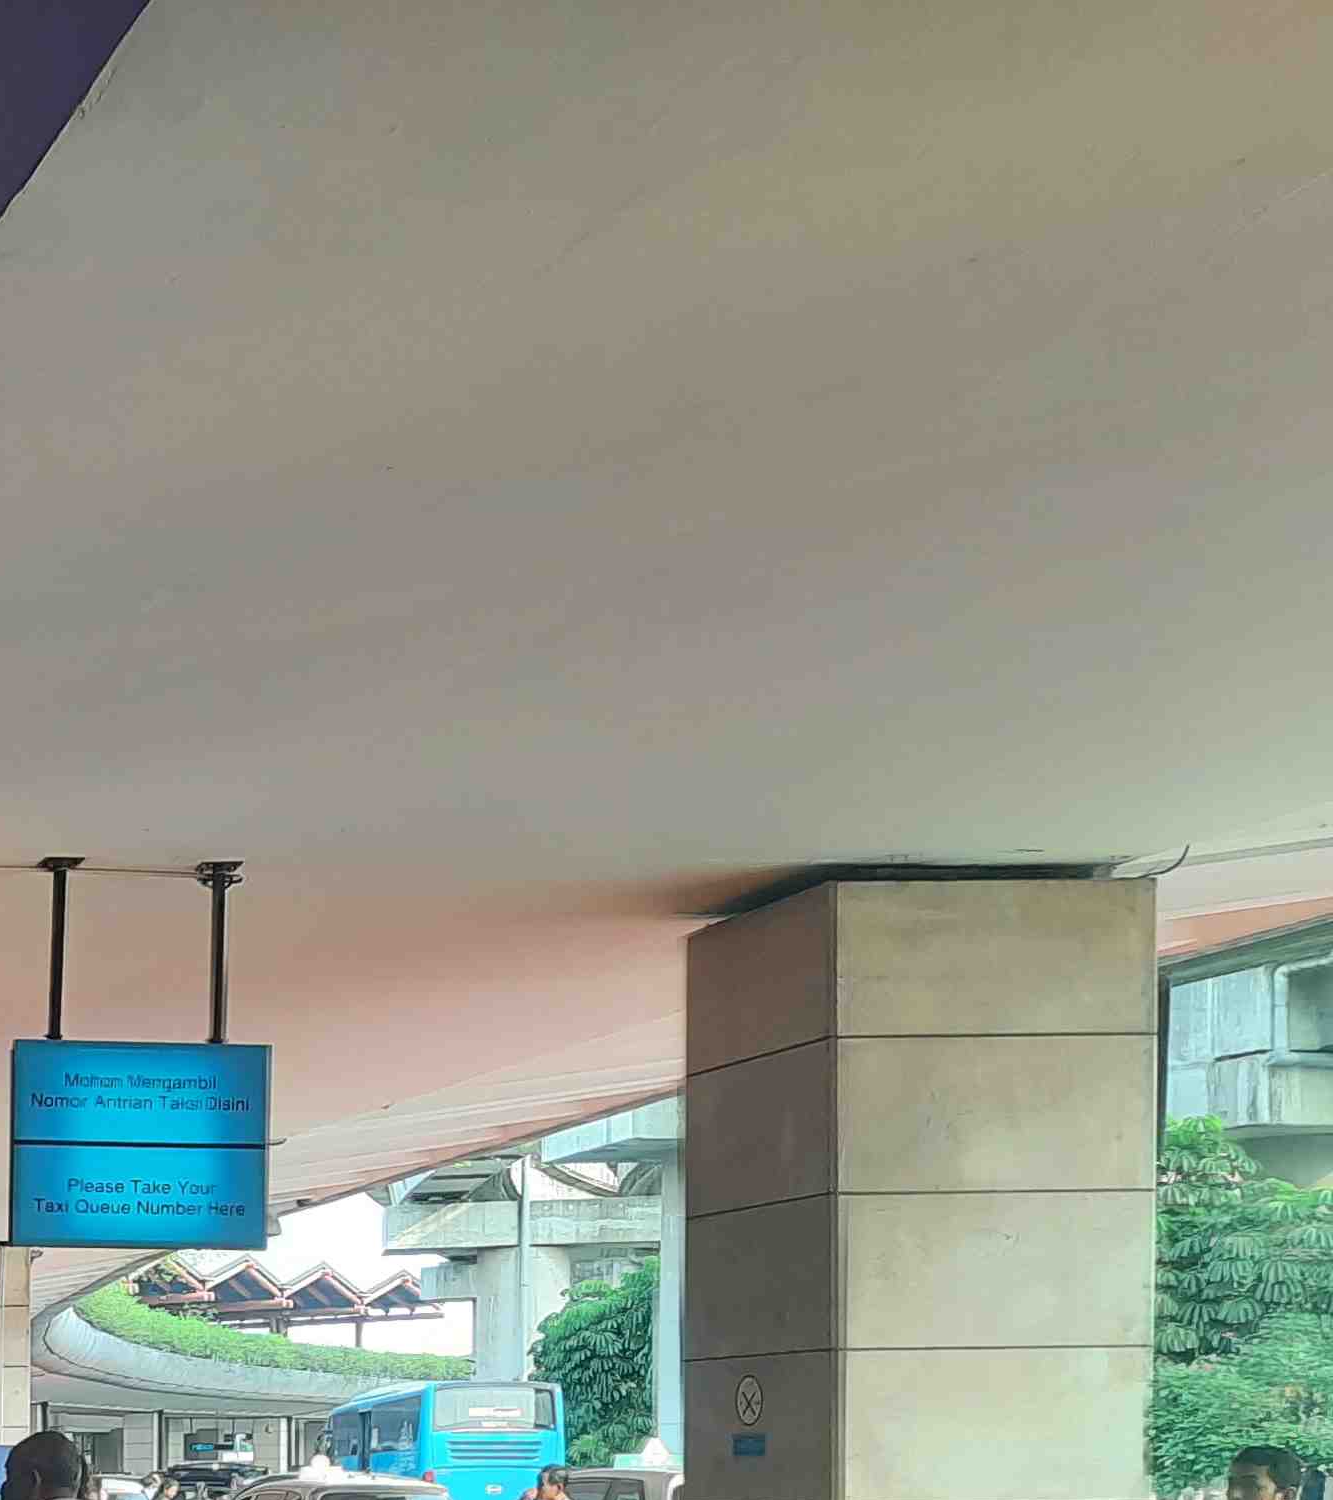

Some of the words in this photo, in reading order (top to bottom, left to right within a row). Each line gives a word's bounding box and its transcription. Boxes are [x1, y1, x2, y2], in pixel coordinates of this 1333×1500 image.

[64, 1072, 121, 1088] Mohon
[128, 1074, 217, 1092] Mengambil
[31, 1093, 88, 1109] Nomor
[95, 1095, 153, 1110] Antrian
[68, 1178, 125, 1193] Please
[132, 1180, 171, 1194] Take
[177, 1180, 217, 1195] Your
[34, 1198, 69, 1213] Taxi
[75, 1199, 130, 1215] Queue
[136, 1200, 202, 1216] Number
[208, 1202, 245, 1216] Here
